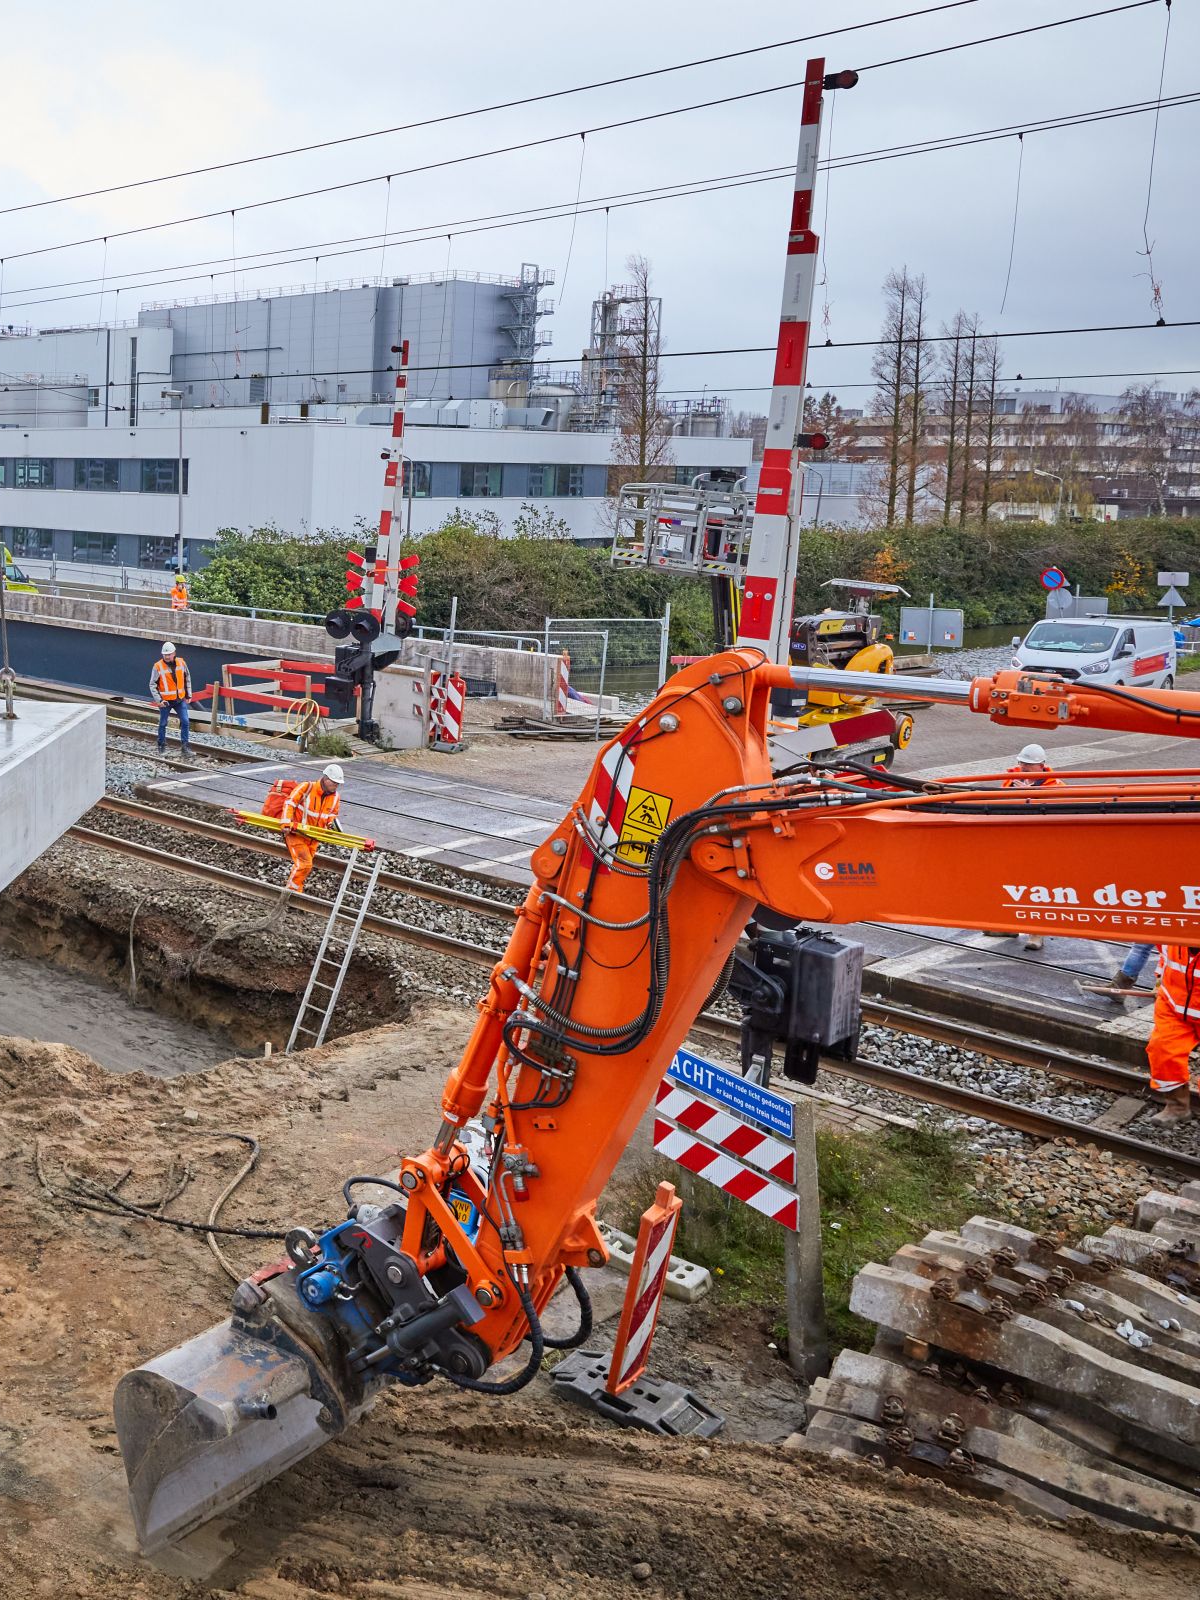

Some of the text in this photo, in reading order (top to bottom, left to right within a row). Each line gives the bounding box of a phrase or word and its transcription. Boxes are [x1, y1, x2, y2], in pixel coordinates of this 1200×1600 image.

[837, 862, 875, 875] ELM
[1002, 884, 1080, 904] van
[1093, 883, 1167, 908] der
[670, 1054, 715, 1090] ACHT
[716, 1074, 725, 1084] tot
[725, 1078, 735, 1088] het
[748, 1089, 761, 1101] licht
[785, 1107, 791, 1116] is
[716, 1087, 791, 1130] er kan nog een trein komen
